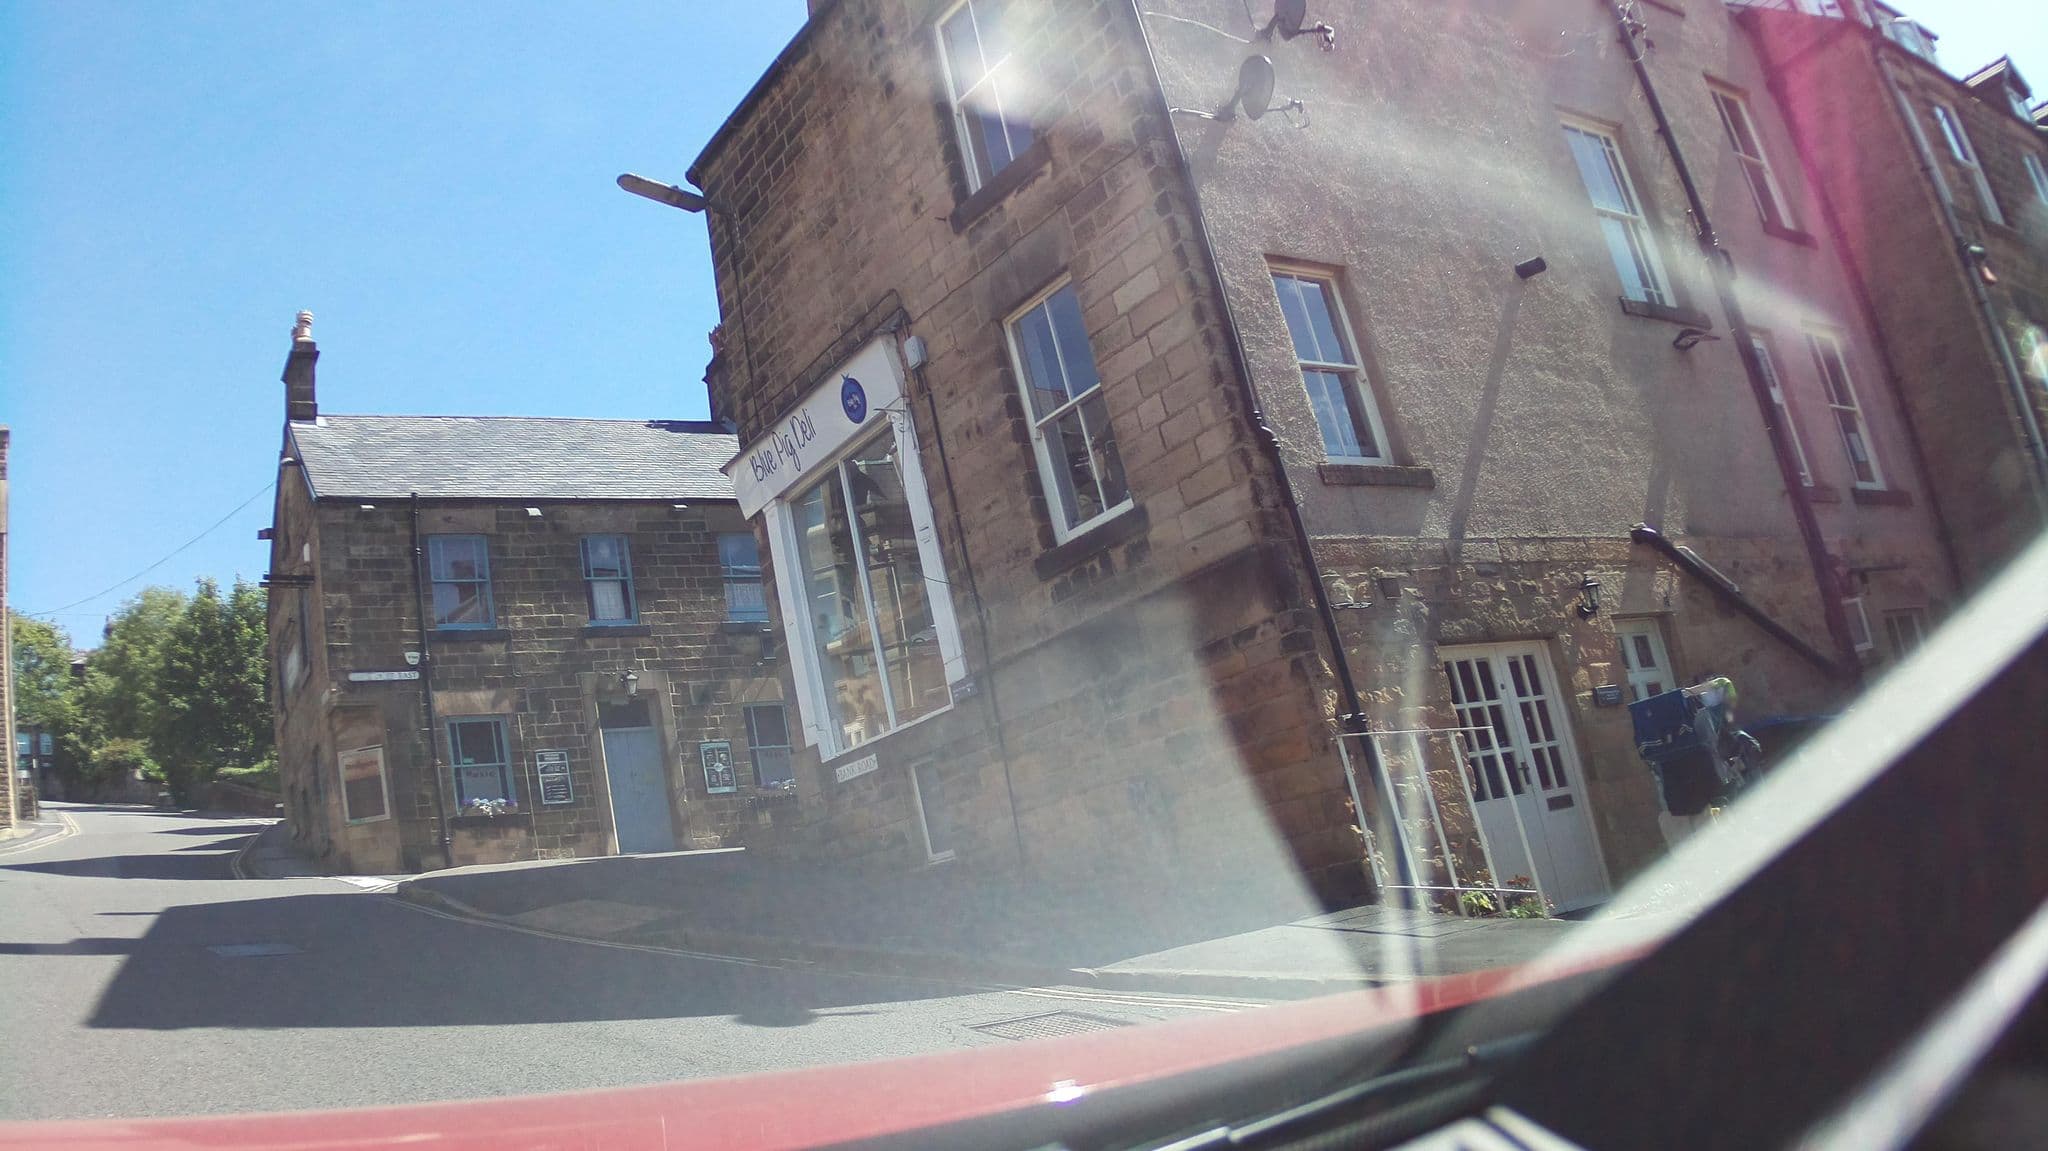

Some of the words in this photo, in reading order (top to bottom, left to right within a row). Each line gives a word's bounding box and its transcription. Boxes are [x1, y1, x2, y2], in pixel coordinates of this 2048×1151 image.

[749, 449, 777, 482] Blue
[772, 431, 801, 472] Pig
[790, 408, 816, 449] Deli
